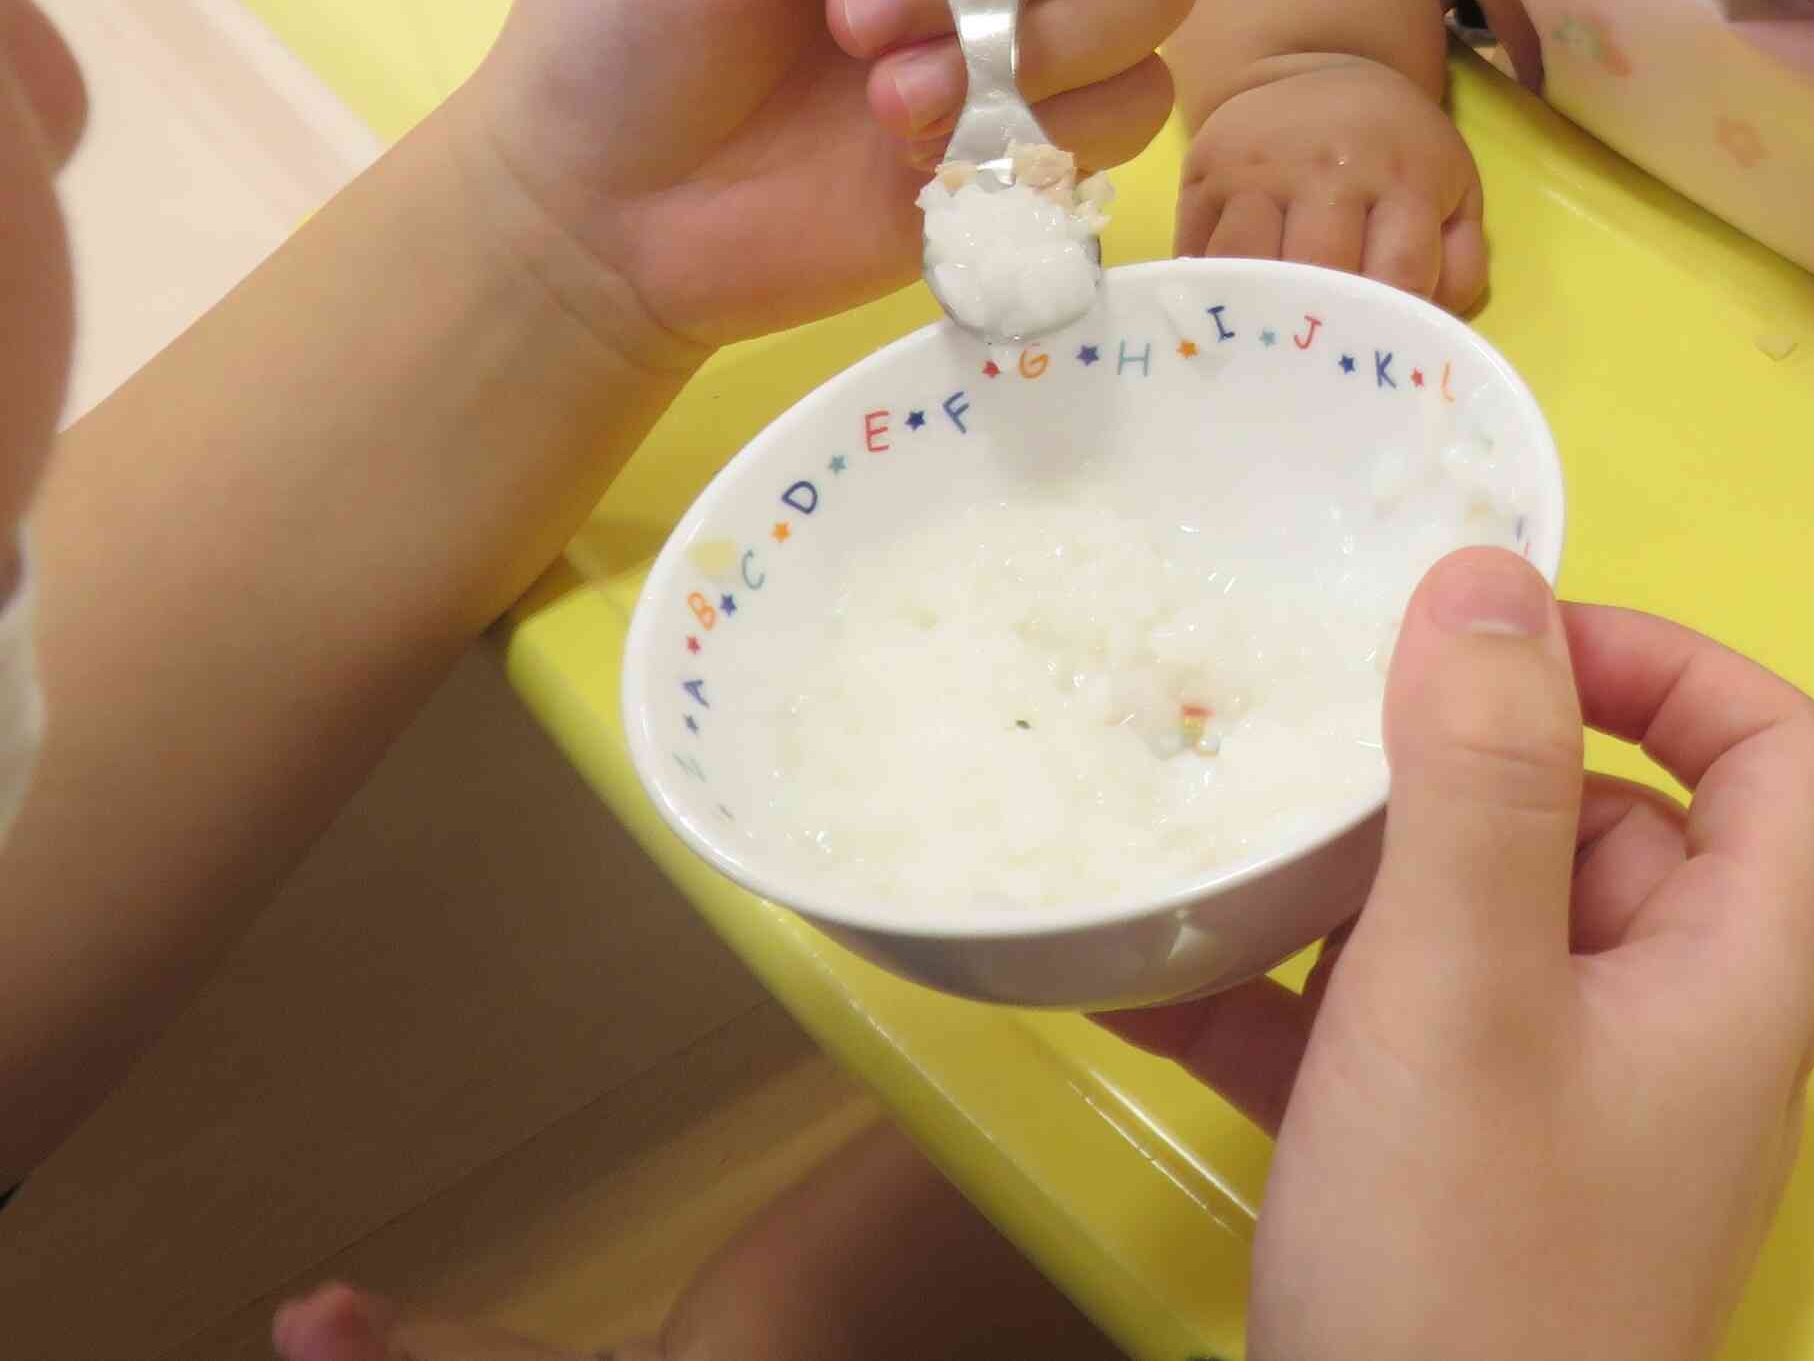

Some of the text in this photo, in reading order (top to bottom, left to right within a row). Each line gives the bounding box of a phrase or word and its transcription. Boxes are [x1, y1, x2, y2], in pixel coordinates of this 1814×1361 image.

[1206, 304, 1236, 343] I
[1293, 314, 1324, 351] J
[1018, 349, 1050, 379] G
[1117, 339, 1151, 377] H
[1374, 349, 1398, 390] K
[864, 410, 890, 453] E
[942, 391, 970, 435] F
[780, 480, 819, 515] D
[741, 548, 766, 591] C
[687, 591, 716, 630] B
[681, 678, 711, 710] A
